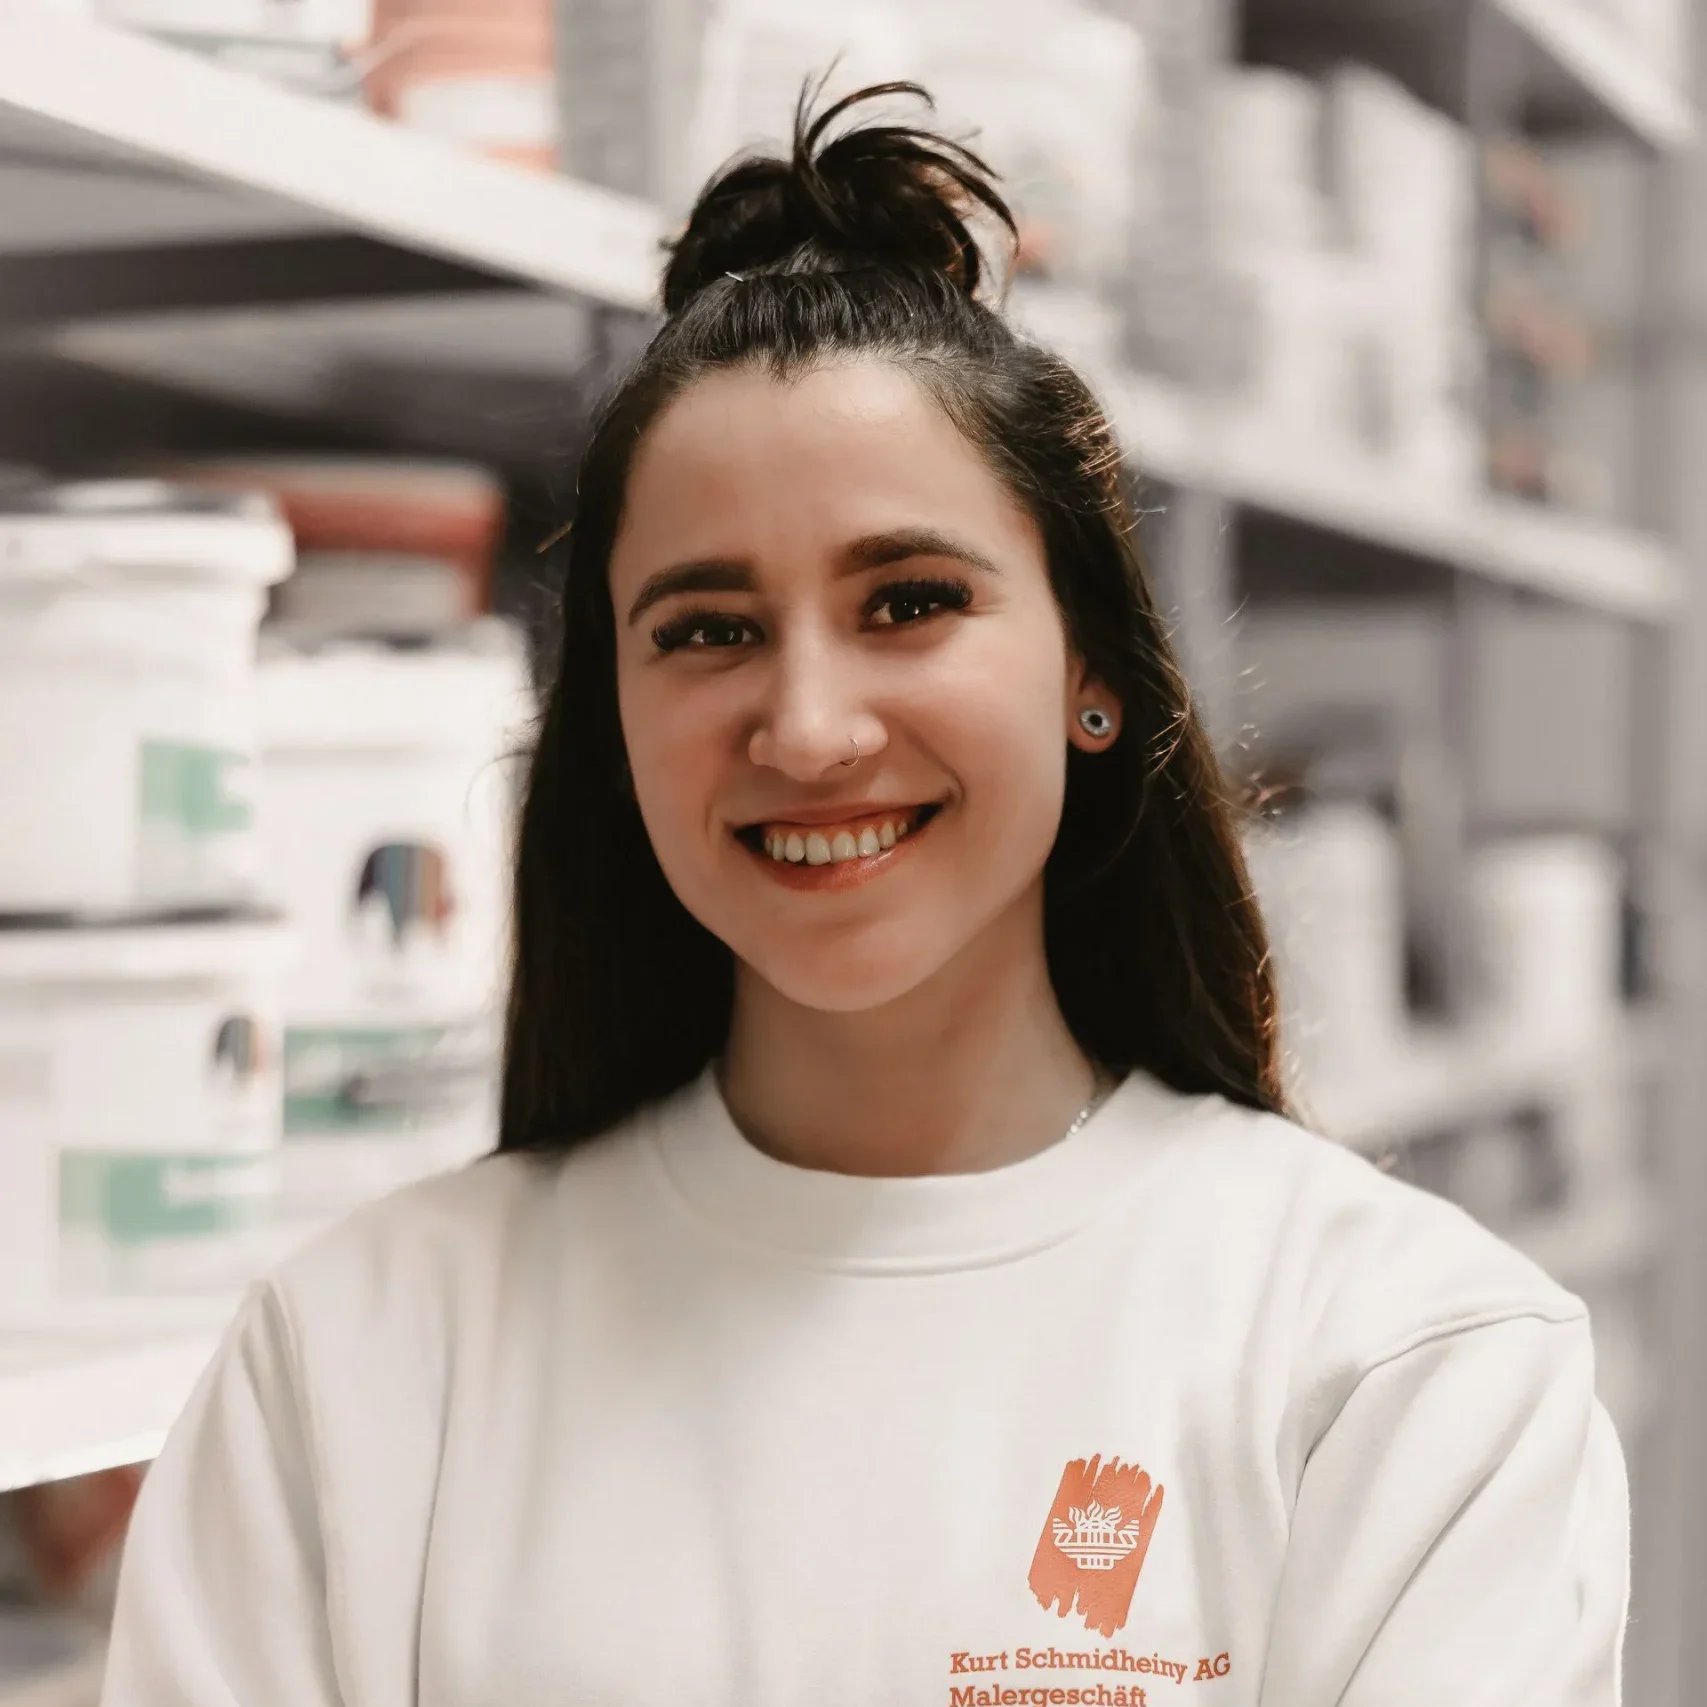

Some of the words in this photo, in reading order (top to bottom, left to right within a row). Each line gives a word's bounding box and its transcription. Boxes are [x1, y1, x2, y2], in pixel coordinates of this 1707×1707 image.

[949, 1652, 1008, 1674] Kurt
[1014, 1647, 1188, 1684] Schmidheiny
[1193, 1652, 1231, 1681] AG
[949, 1684, 1146, 1707] Malergeschäft
